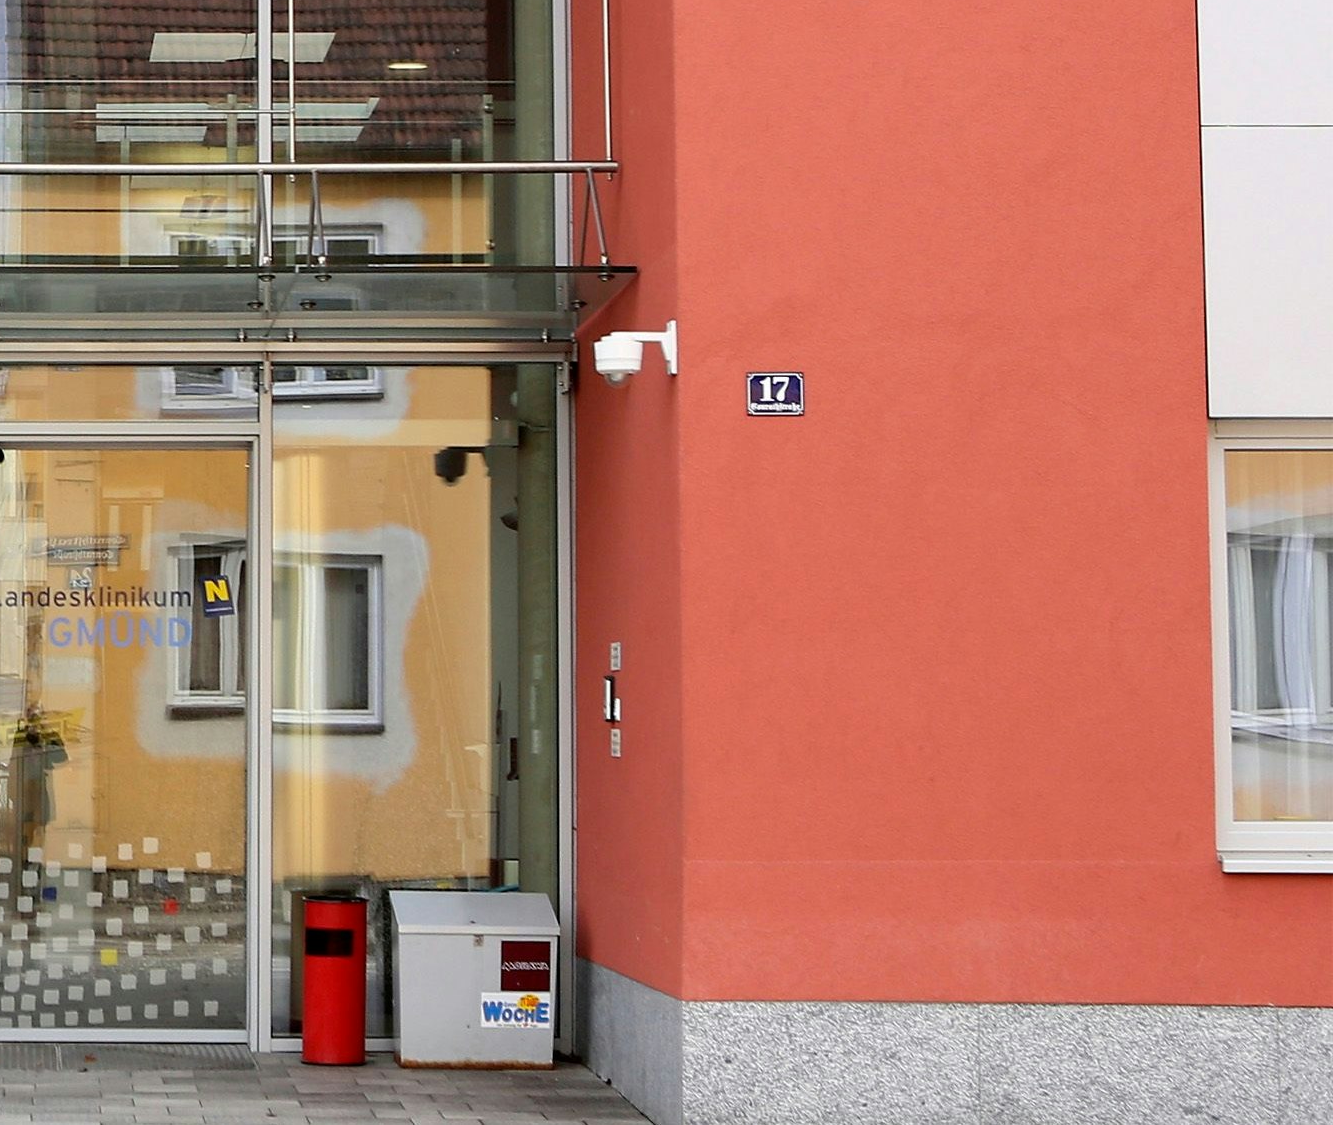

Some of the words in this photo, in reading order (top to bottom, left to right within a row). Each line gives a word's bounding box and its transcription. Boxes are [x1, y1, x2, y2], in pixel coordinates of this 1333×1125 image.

[759, 376, 790, 402] 17
[204, 579, 230, 603] N
[48, 610, 192, 648] GMÜND
